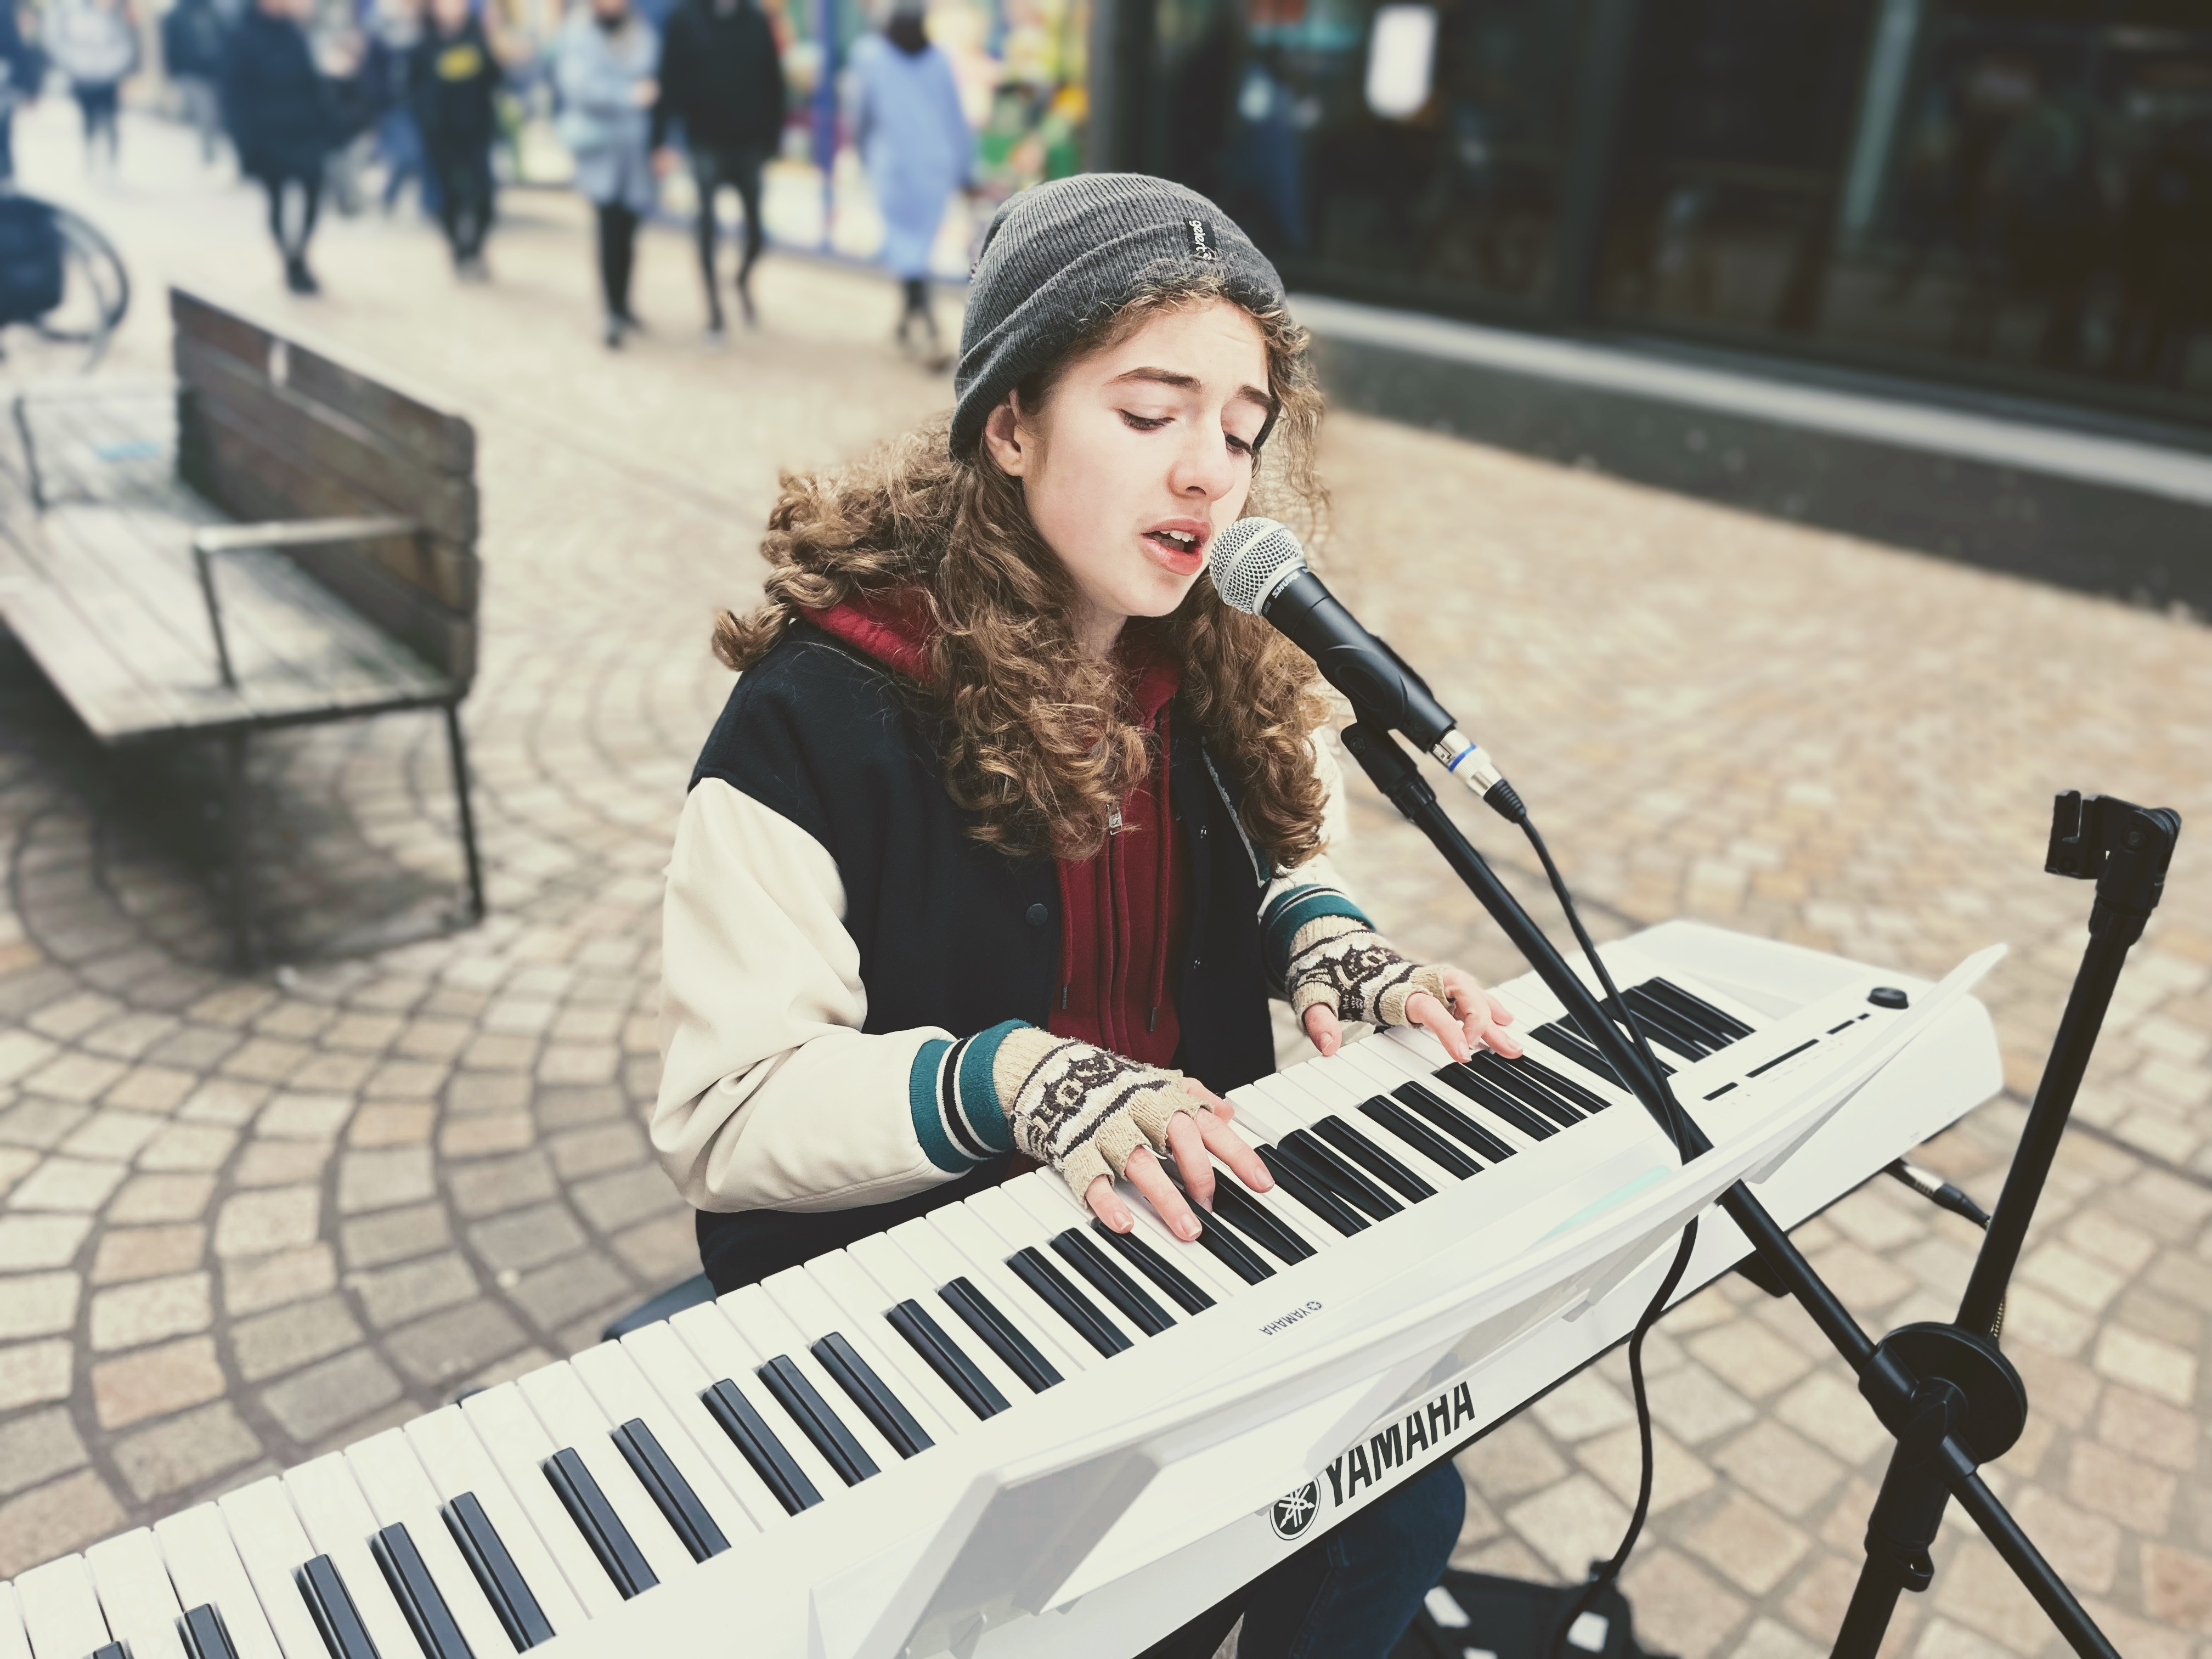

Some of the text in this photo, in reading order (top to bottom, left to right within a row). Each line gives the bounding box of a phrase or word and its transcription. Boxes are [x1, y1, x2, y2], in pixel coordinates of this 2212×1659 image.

[1188, 220, 1207, 252] gelert
[1272, 570, 1301, 599] SHURE
[1259, 1308, 1312, 1335] YAMAHA
[1325, 1381, 1476, 1508] YAMAHA
